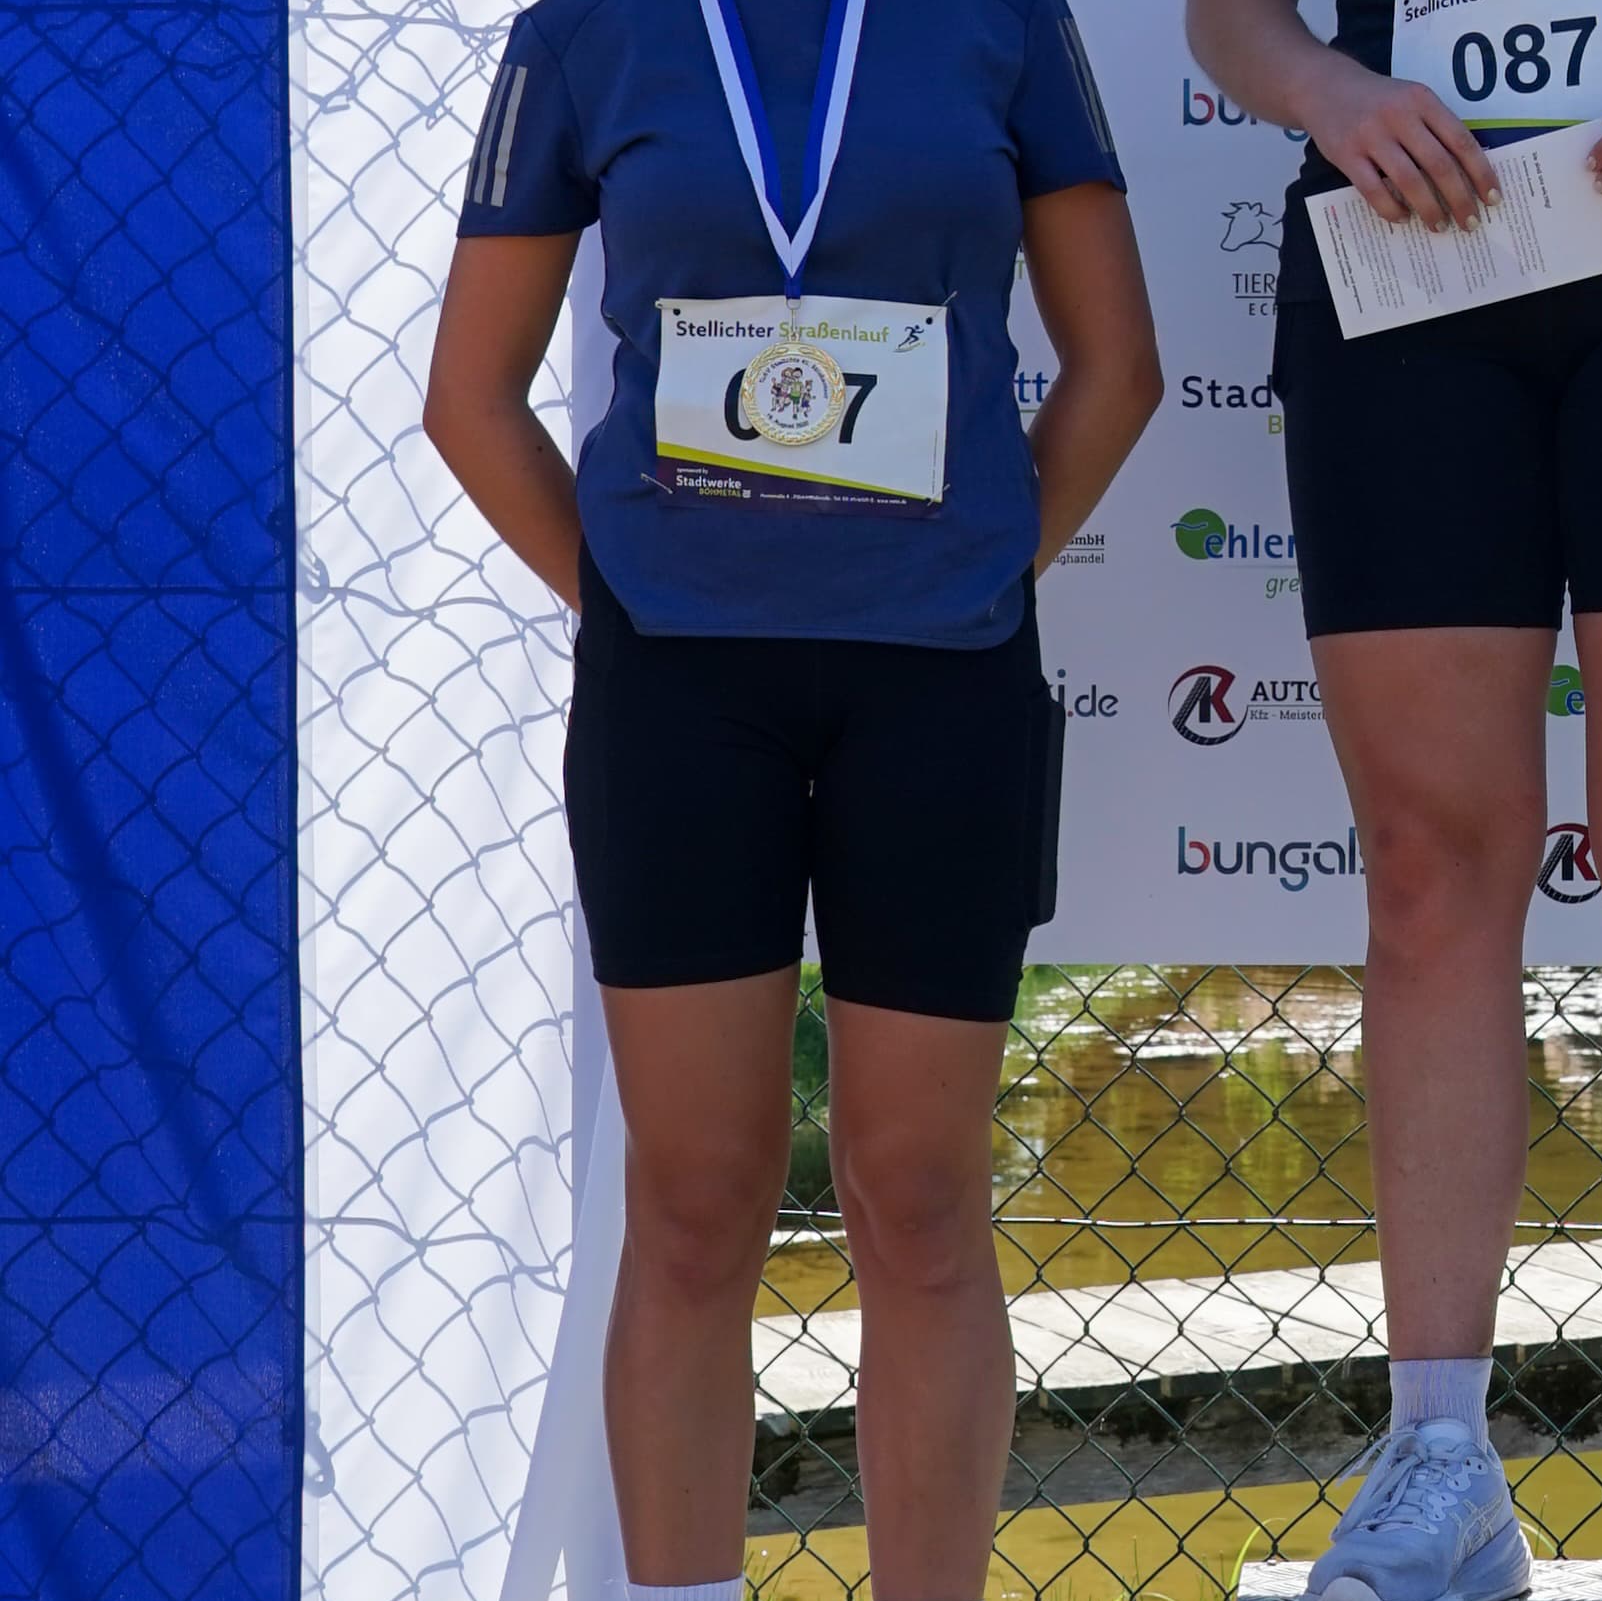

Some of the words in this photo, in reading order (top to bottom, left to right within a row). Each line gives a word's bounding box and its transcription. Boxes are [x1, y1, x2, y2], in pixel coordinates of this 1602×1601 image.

[1451, 15, 1598, 102] 087
[676, 320, 775, 339] Stellichter
[724, 367, 878, 444] 07
[676, 474, 742, 489] Stadtwerke
[1250, 709, 1269, 720] Kfz
[1178, 826, 1365, 892] bungal
